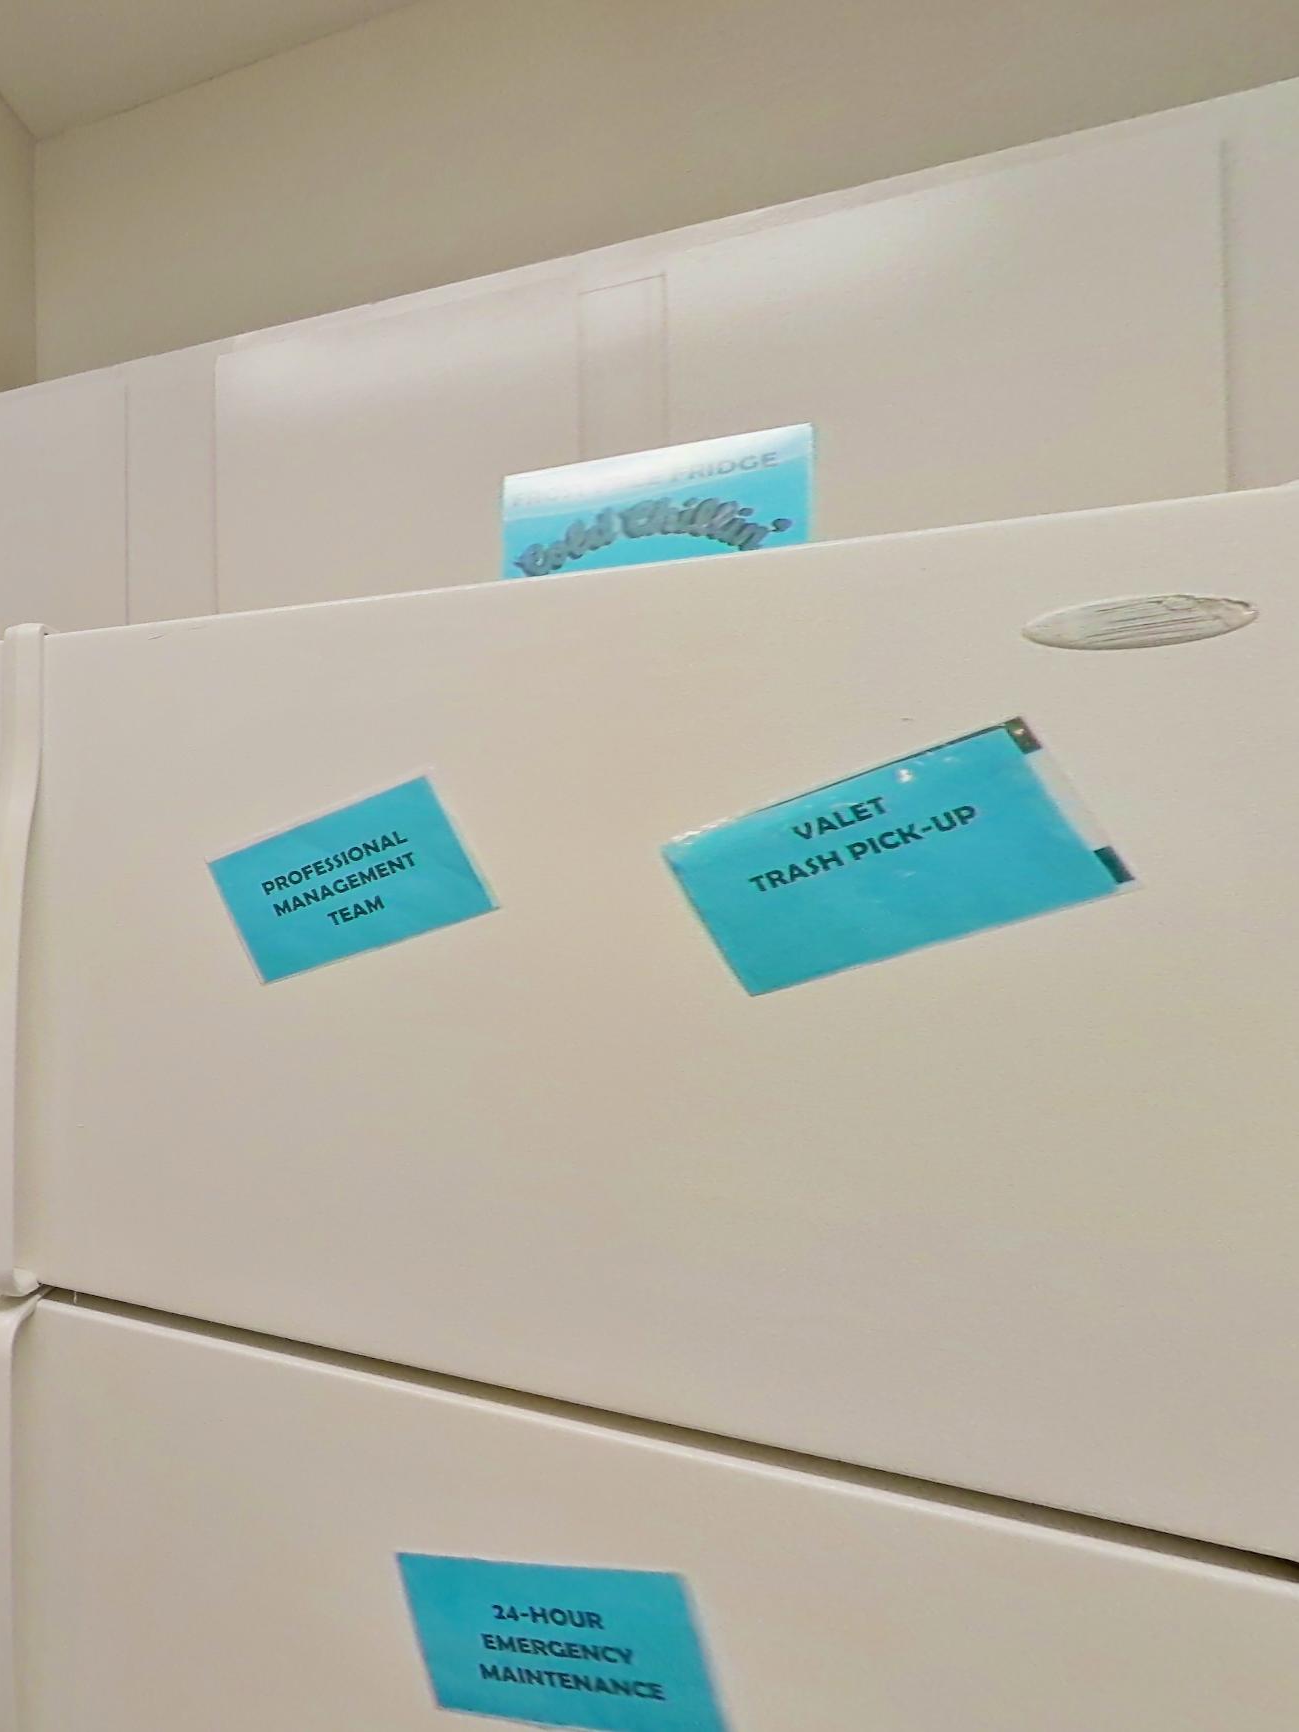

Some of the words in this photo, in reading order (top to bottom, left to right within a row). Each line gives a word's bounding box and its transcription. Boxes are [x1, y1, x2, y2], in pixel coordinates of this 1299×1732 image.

[791, 797, 885, 840] VALET
[261, 830, 409, 896] PROFESSIONAL
[748, 850, 845, 893] TRASH
[846, 804, 977, 862] PICK-UP
[272, 852, 417, 917] MANAGEMENT
[327, 895, 386, 926] TEAM
[491, 1604, 605, 1630] 24-HOUR
[480, 1632, 634, 1666] EMERGENCY
[478, 1662, 667, 1701] MAINTENANCE
